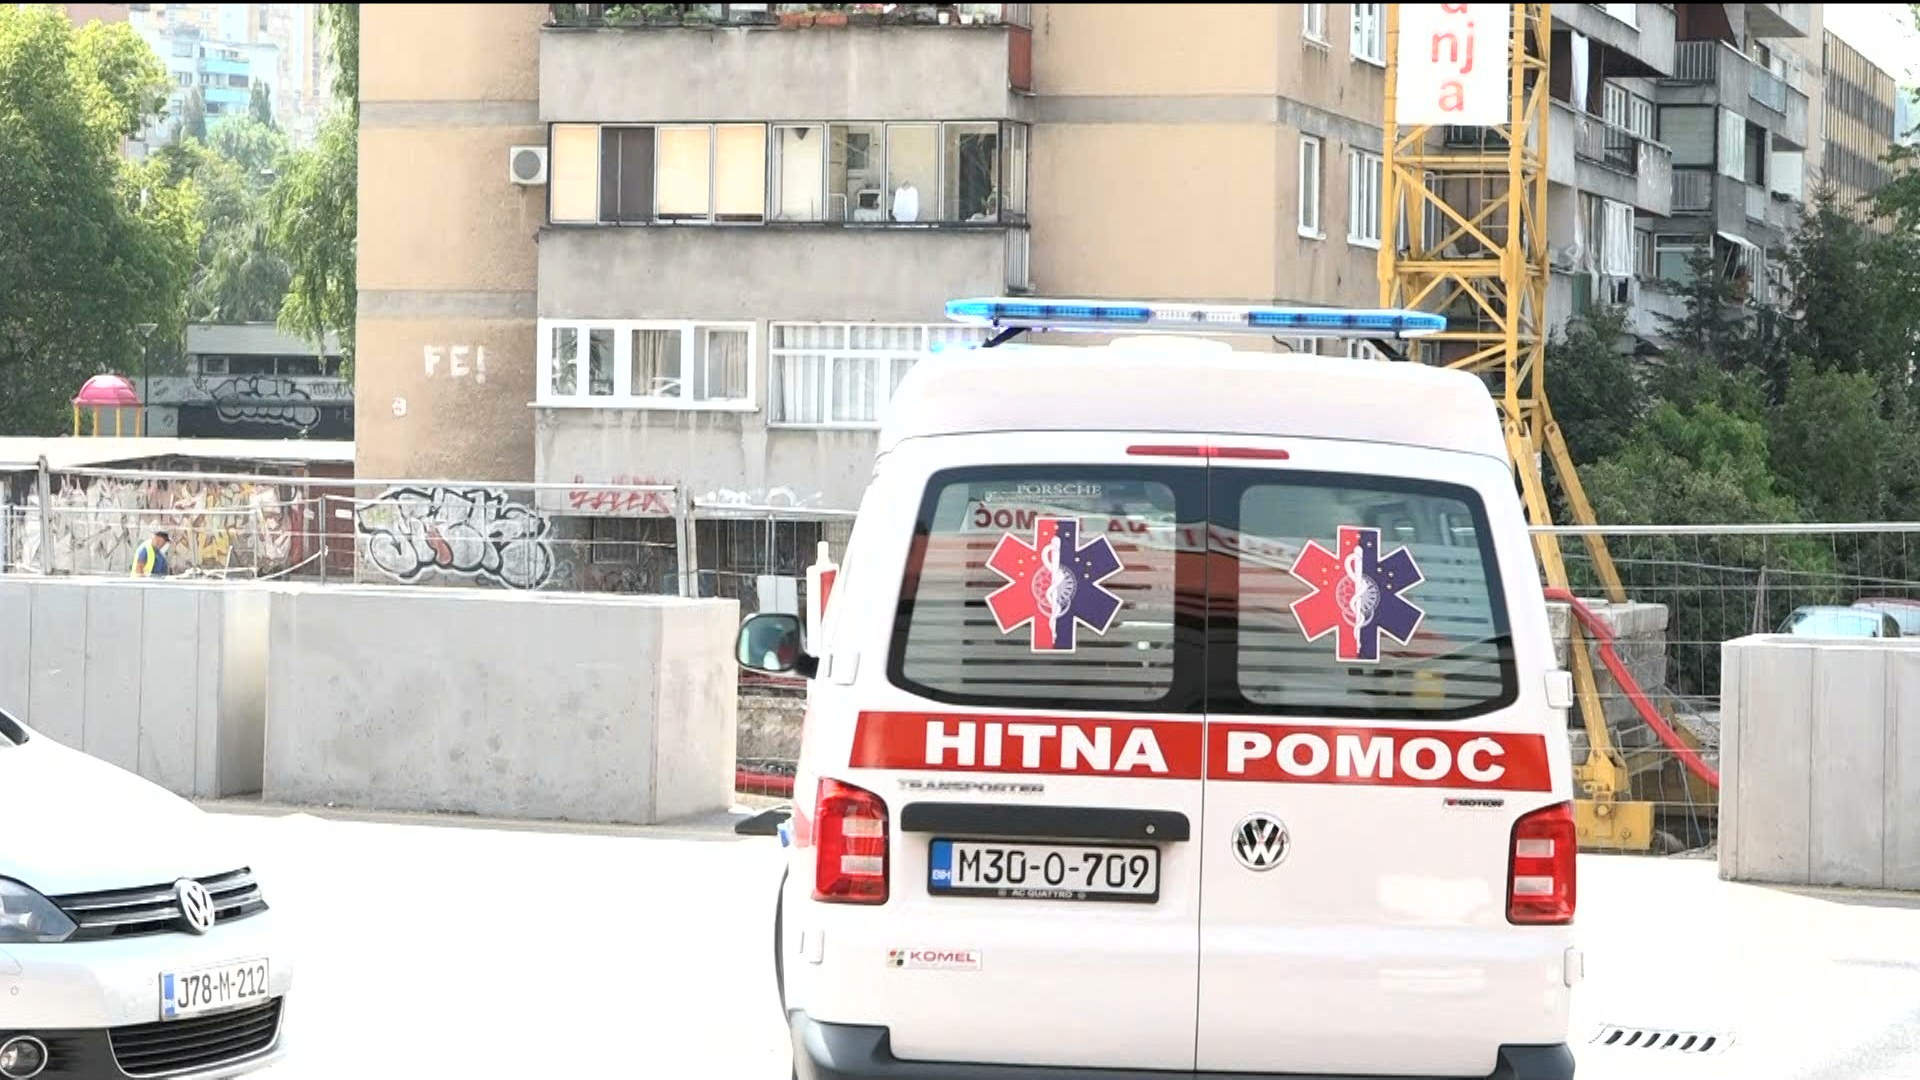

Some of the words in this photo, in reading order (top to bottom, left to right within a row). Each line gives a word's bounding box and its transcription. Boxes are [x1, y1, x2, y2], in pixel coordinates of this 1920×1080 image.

[1017, 483, 1103, 496] PORSCHE
[925, 720, 1169, 773] HITNA
[898, 779, 1045, 793] TRANSPORTER
[910, 951, 977, 963] KOMEL
[177, 964, 266, 1008] J78-M-212
